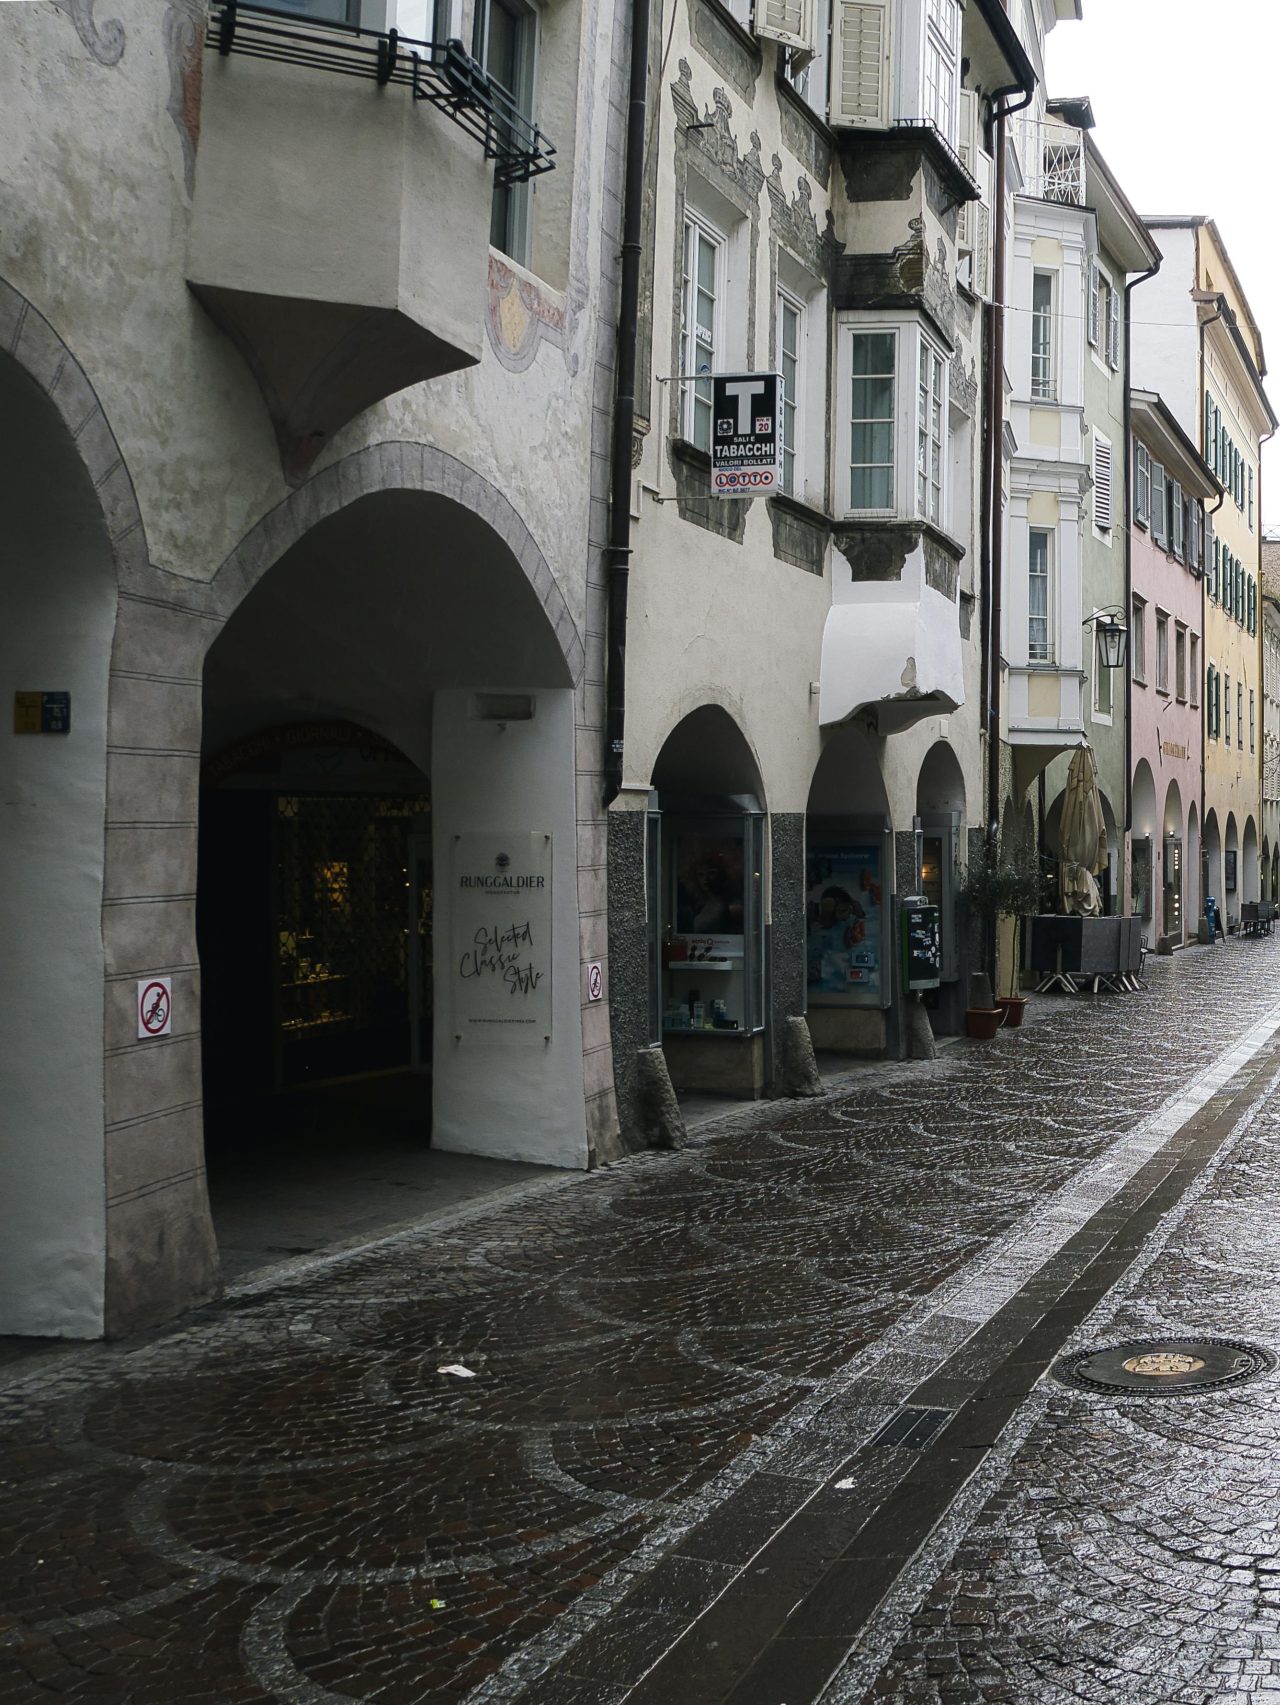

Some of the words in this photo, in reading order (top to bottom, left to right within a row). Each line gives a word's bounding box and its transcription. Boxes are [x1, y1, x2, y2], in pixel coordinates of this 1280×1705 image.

[725, 381, 765, 435] T
[758, 423, 769, 432] 20
[715, 443, 775, 458] TABACCHI
[715, 471, 774, 487] LOTTO
[460, 875, 545, 888] RUNGGALDIER
[474, 921, 533, 954] Selected
[460, 950, 520, 978] Classic
[504, 962, 544, 994] Style
